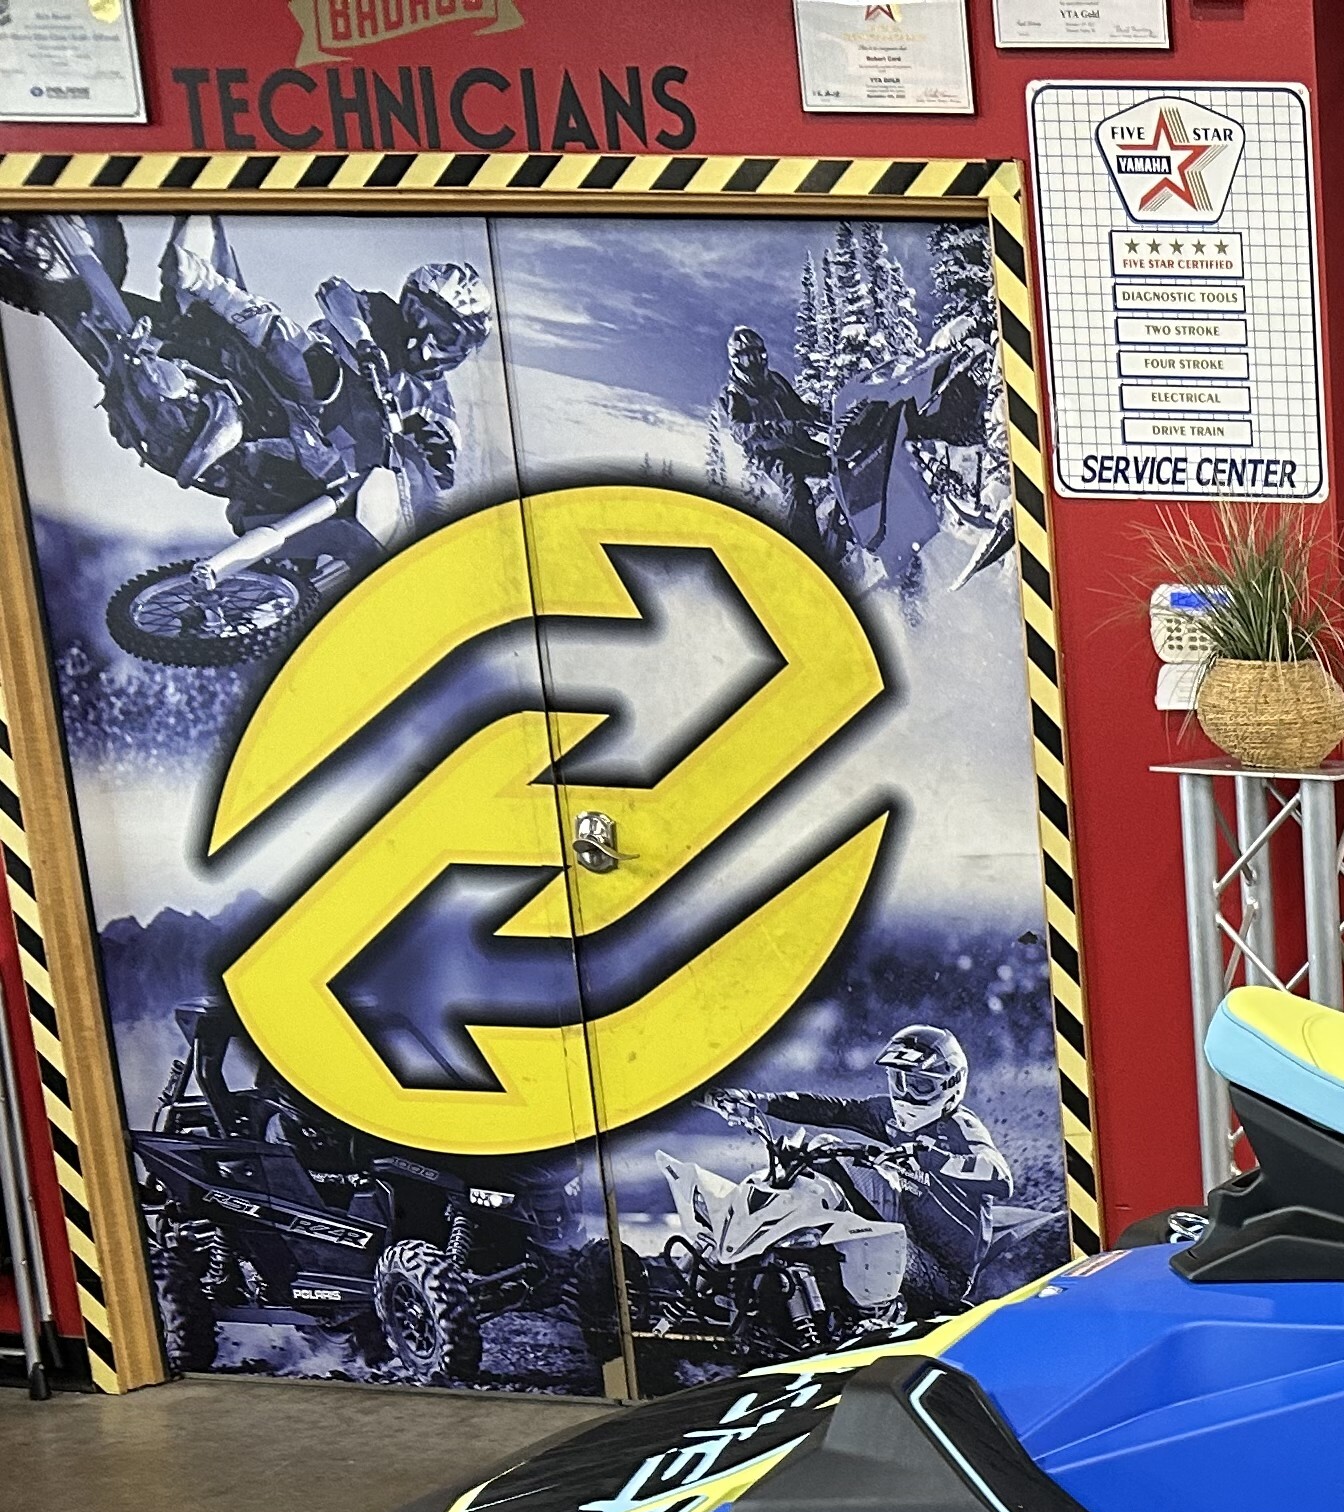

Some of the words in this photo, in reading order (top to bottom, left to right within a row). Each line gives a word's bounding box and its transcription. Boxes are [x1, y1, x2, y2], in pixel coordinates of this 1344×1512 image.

[171, 66, 697, 151] TECHNICIANS
[1111, 126, 1145, 141] FIVE
[1193, 127, 1233, 141] STAR
[1118, 157, 1170, 173] YAMAHA
[1123, 259, 1145, 269] FIVE
[1148, 259, 1174, 269] STAR
[1177, 260, 1233, 270] CERTIFIED
[1122, 291, 1196, 302] DIAGNOSTIC
[1200, 292, 1238, 303] TOOLS
[1144, 325, 1171, 336] TWO
[1175, 325, 1220, 336] STROKE
[1144, 358, 1176, 369] FOUR
[1179, 359, 1224, 370] STROKE
[1151, 392, 1221, 403] ELECTRICAL
[1152, 425, 1186, 436] DRIVE
[1190, 426, 1225, 437] TRAIN
[1081, 454, 1188, 485] SERVICE
[1195, 457, 1297, 489] CENTER
[293, 1289, 341, 1301] POLARIS
